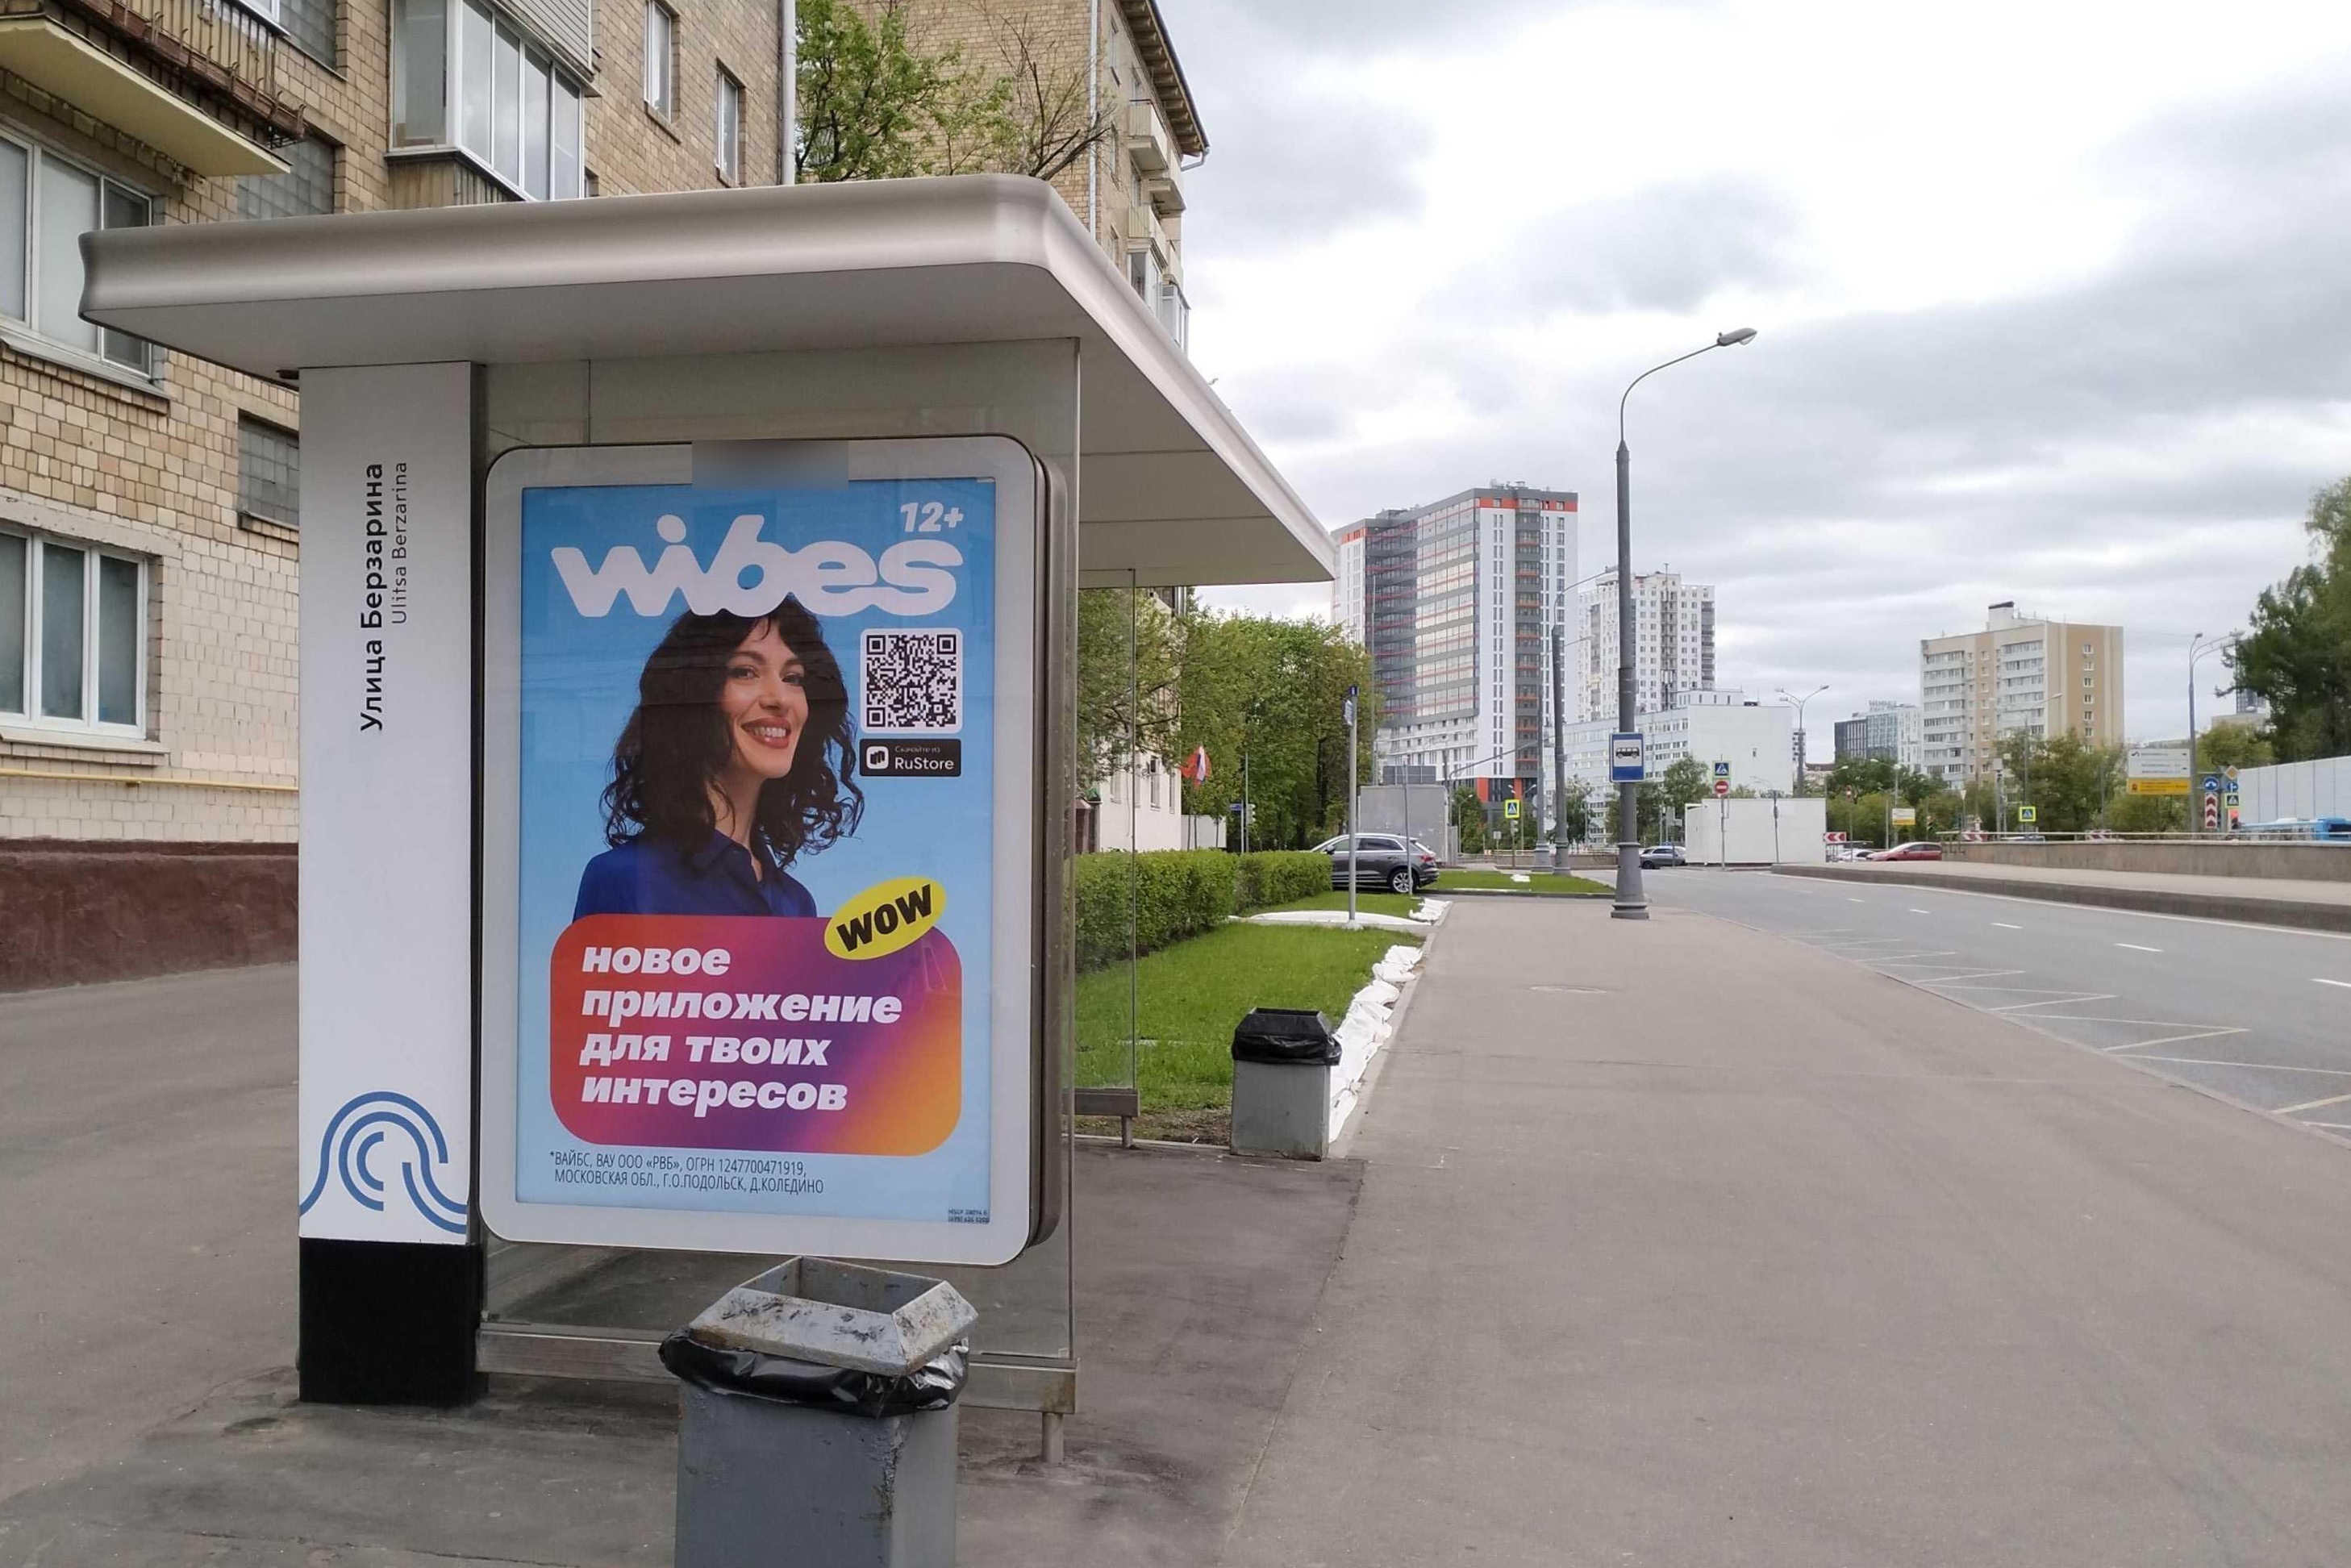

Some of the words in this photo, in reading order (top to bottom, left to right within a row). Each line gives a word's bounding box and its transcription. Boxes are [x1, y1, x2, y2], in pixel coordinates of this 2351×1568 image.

[391, 462, 407, 559] Berzarina
[900, 502, 964, 532] 12+
[361, 464, 387, 629] Берзарина
[391, 565, 407, 625] Ulitsa
[360, 640, 386, 732] Улица
[894, 757, 955, 770] RuStore
[581, 946, 732, 976] новое
[581, 990, 902, 1028] приложение
[579, 1033, 672, 1066] для
[686, 1036, 832, 1066] твоих
[581, 1077, 848, 1118] интересов
[596, 1153, 615, 1168] ВАУ
[618, 1154, 643, 1169] ООО
[686, 1157, 715, 1172] ОГРН
[554, 1170, 627, 1186] МОСКОВСКАЯ
[631, 1172, 660, 1189] ОБЛ.,
[750, 1177, 824, 1195] Д.КОЛЕДИНО
